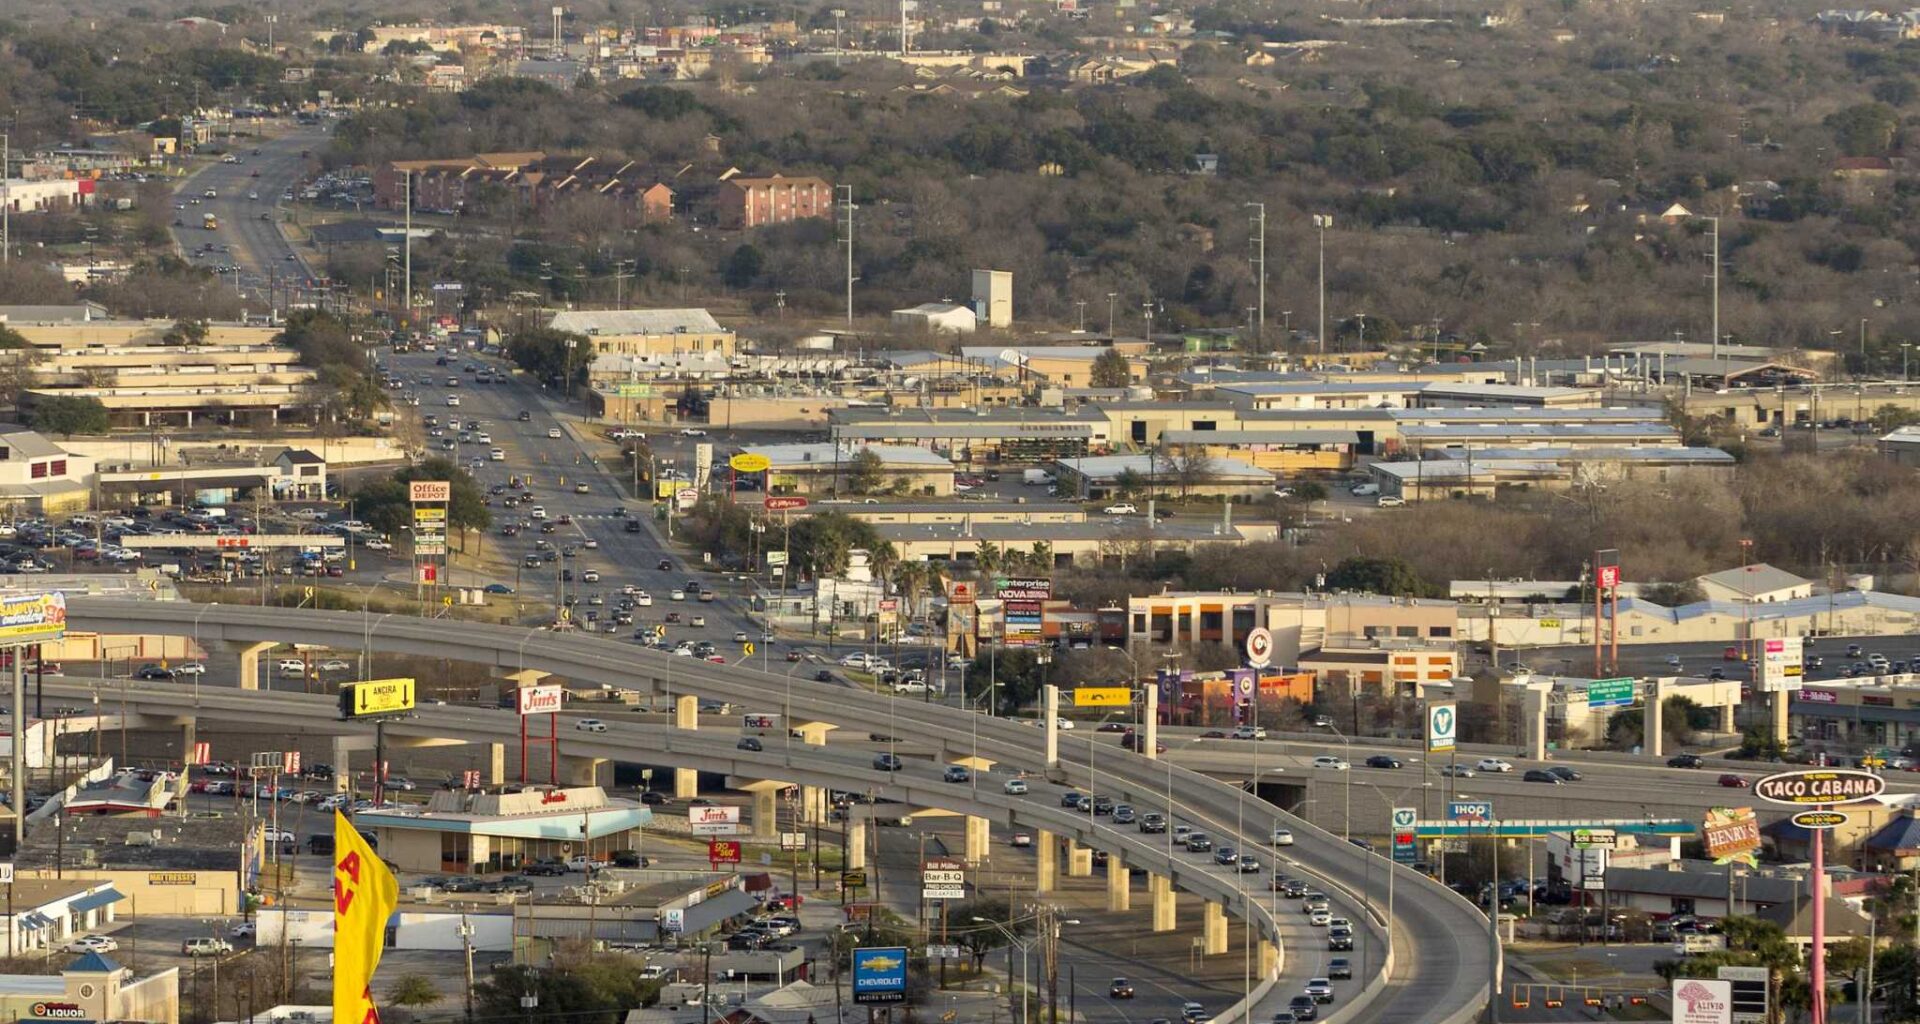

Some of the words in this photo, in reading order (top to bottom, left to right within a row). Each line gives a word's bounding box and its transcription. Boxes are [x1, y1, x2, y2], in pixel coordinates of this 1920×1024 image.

[413, 484, 447, 492] Office
[997, 579, 1050, 588] enterprise
[999, 590, 1027, 598] NOVA
[524, 692, 557, 710] Jim's
[744, 716, 773, 728] FedEx
[1764, 781, 1806, 796] TACO
[1811, 779, 1876, 795] CABANA
[700, 808, 728, 821] Jim's
[1455, 805, 1486, 817] IHOP
[1708, 822, 1756, 847] HENRY'S
[858, 977, 902, 986] CHEVROLET
[1696, 1001, 1724, 1010] ALIVIO
[46, 1008, 85, 1018] LIQUOR
